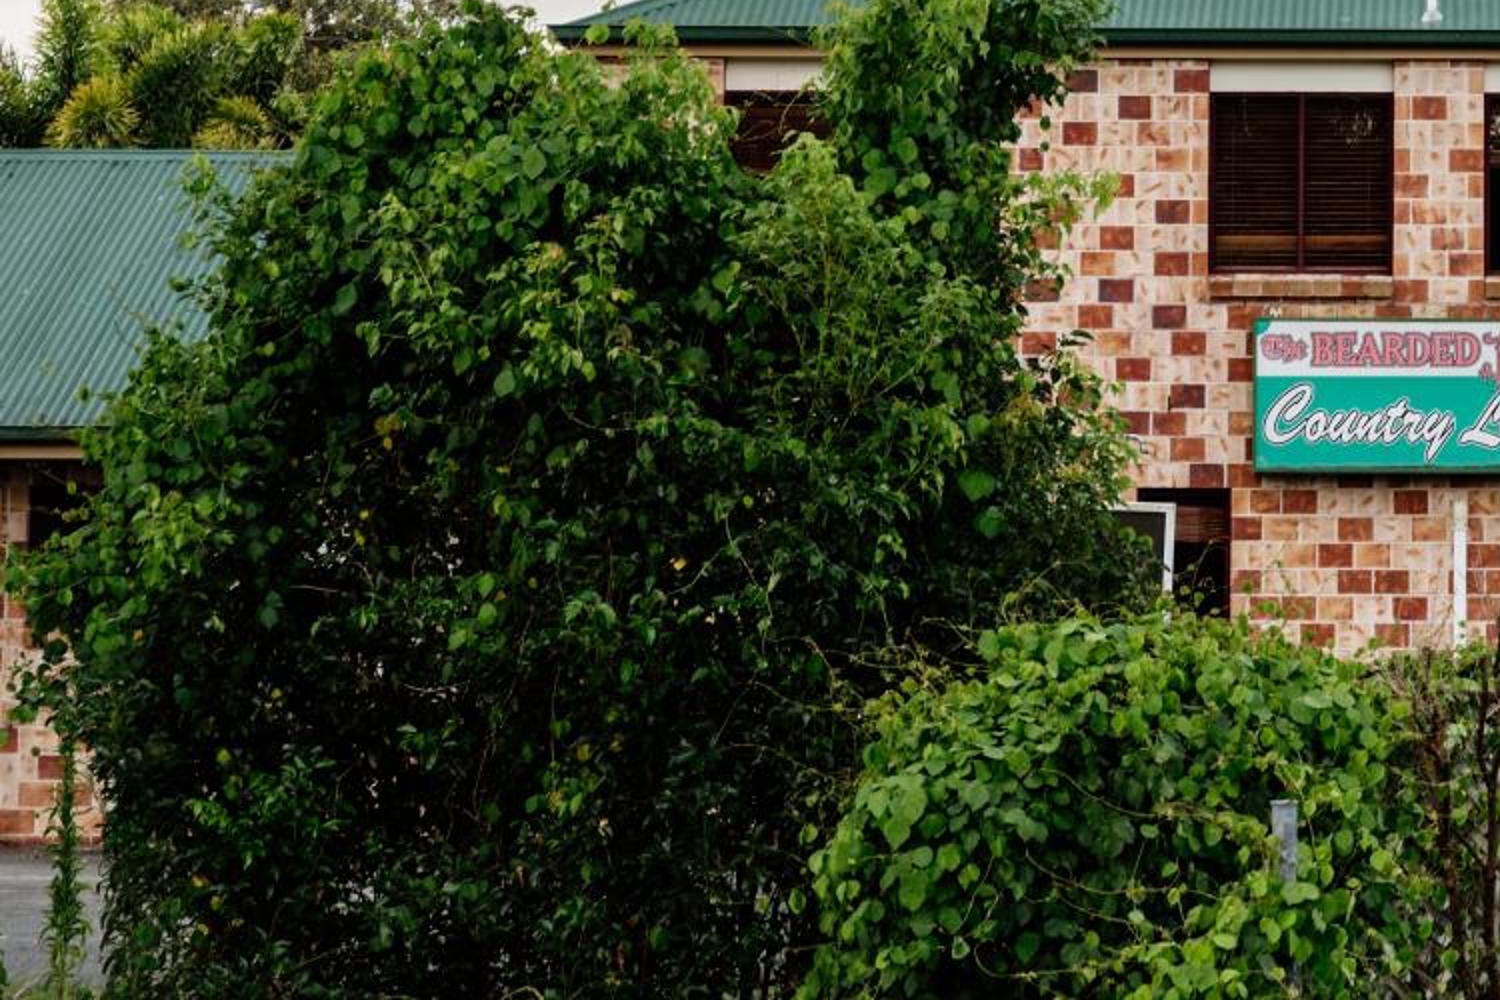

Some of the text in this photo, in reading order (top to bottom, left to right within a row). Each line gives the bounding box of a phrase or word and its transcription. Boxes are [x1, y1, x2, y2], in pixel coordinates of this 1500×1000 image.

[1261, 333, 1309, 362] The
[1311, 331, 1481, 368] BEARDED
[1262, 383, 1456, 464] Country
